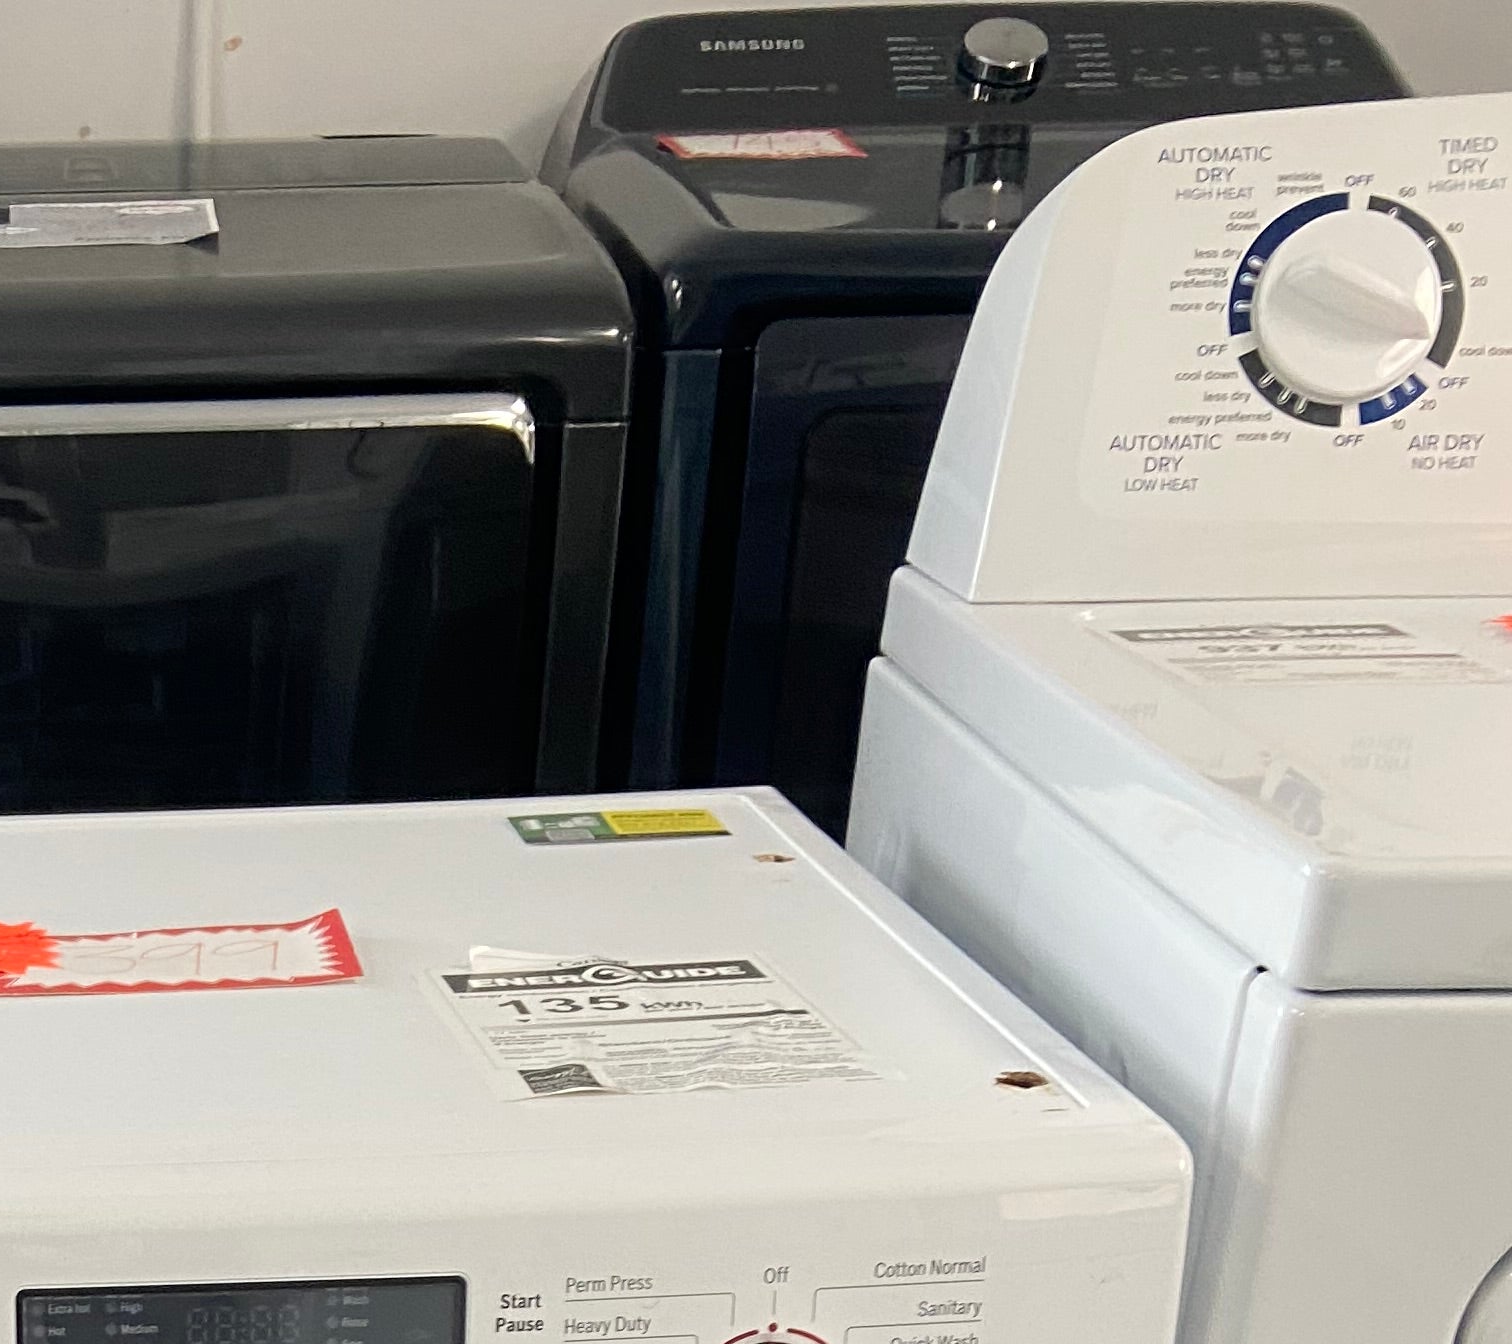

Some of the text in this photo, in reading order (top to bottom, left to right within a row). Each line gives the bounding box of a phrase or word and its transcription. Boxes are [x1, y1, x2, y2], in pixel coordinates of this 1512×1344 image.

[700, 39, 805, 51] SAMSUNG
[1438, 136, 1499, 155] TIMED
[1157, 146, 1273, 164] AUTOMATIC
[1447, 158, 1489, 175] DRY
[1195, 167, 1236, 183] DRY
[1345, 174, 1375, 188] OFF
[1276, 184, 1324, 197] prevent
[1427, 177, 1508, 193] HIGH HEAT
[1175, 186, 1255, 201] HIGH HEAT
[1228, 208, 1257, 219] cool
[1225, 221, 1261, 232] down
[1446, 222, 1465, 233] 40
[1194, 248, 1244, 260] less dry
[1184, 267, 1230, 278] energy
[1170, 278, 1229, 291] preferred
[1469, 276, 1488, 288] 20
[1170, 301, 1228, 313] more dry
[1196, 344, 1228, 357] OFF
[1459, 345, 1487, 357] cool
[1175, 370, 1239, 381] cool down
[1438, 376, 1470, 390] OFF
[1203, 391, 1252, 403] less dry
[1419, 399, 1437, 411] 20
[1168, 412, 1273, 426] energy preferred
[1390, 418, 1406, 430] 10
[1109, 433, 1223, 451] AUTOMATIC
[1235, 430, 1292, 443] more dry
[1333, 434, 1365, 447] OFF
[1407, 433, 1486, 451] AIR DRY
[1143, 456, 1184, 473] DRY
[1411, 455, 1478, 470] NO HEAT
[1124, 477, 1200, 492] LOW HEAT
[63, 939, 279, 977] 399
[498, 995, 630, 1023] 135
[763, 1265, 791, 1284] Off
[874, 1256, 987, 1279] Cotton Normal
[565, 1275, 654, 1294] Perm Press
[500, 1293, 543, 1309] Start
[120, 1302, 144, 1315] High
[917, 1299, 984, 1318] Sanitary
[48, 1327, 66, 1336] Hot
[495, 1317, 545, 1333] Pause
[563, 1316, 652, 1336] Heavy Duty
